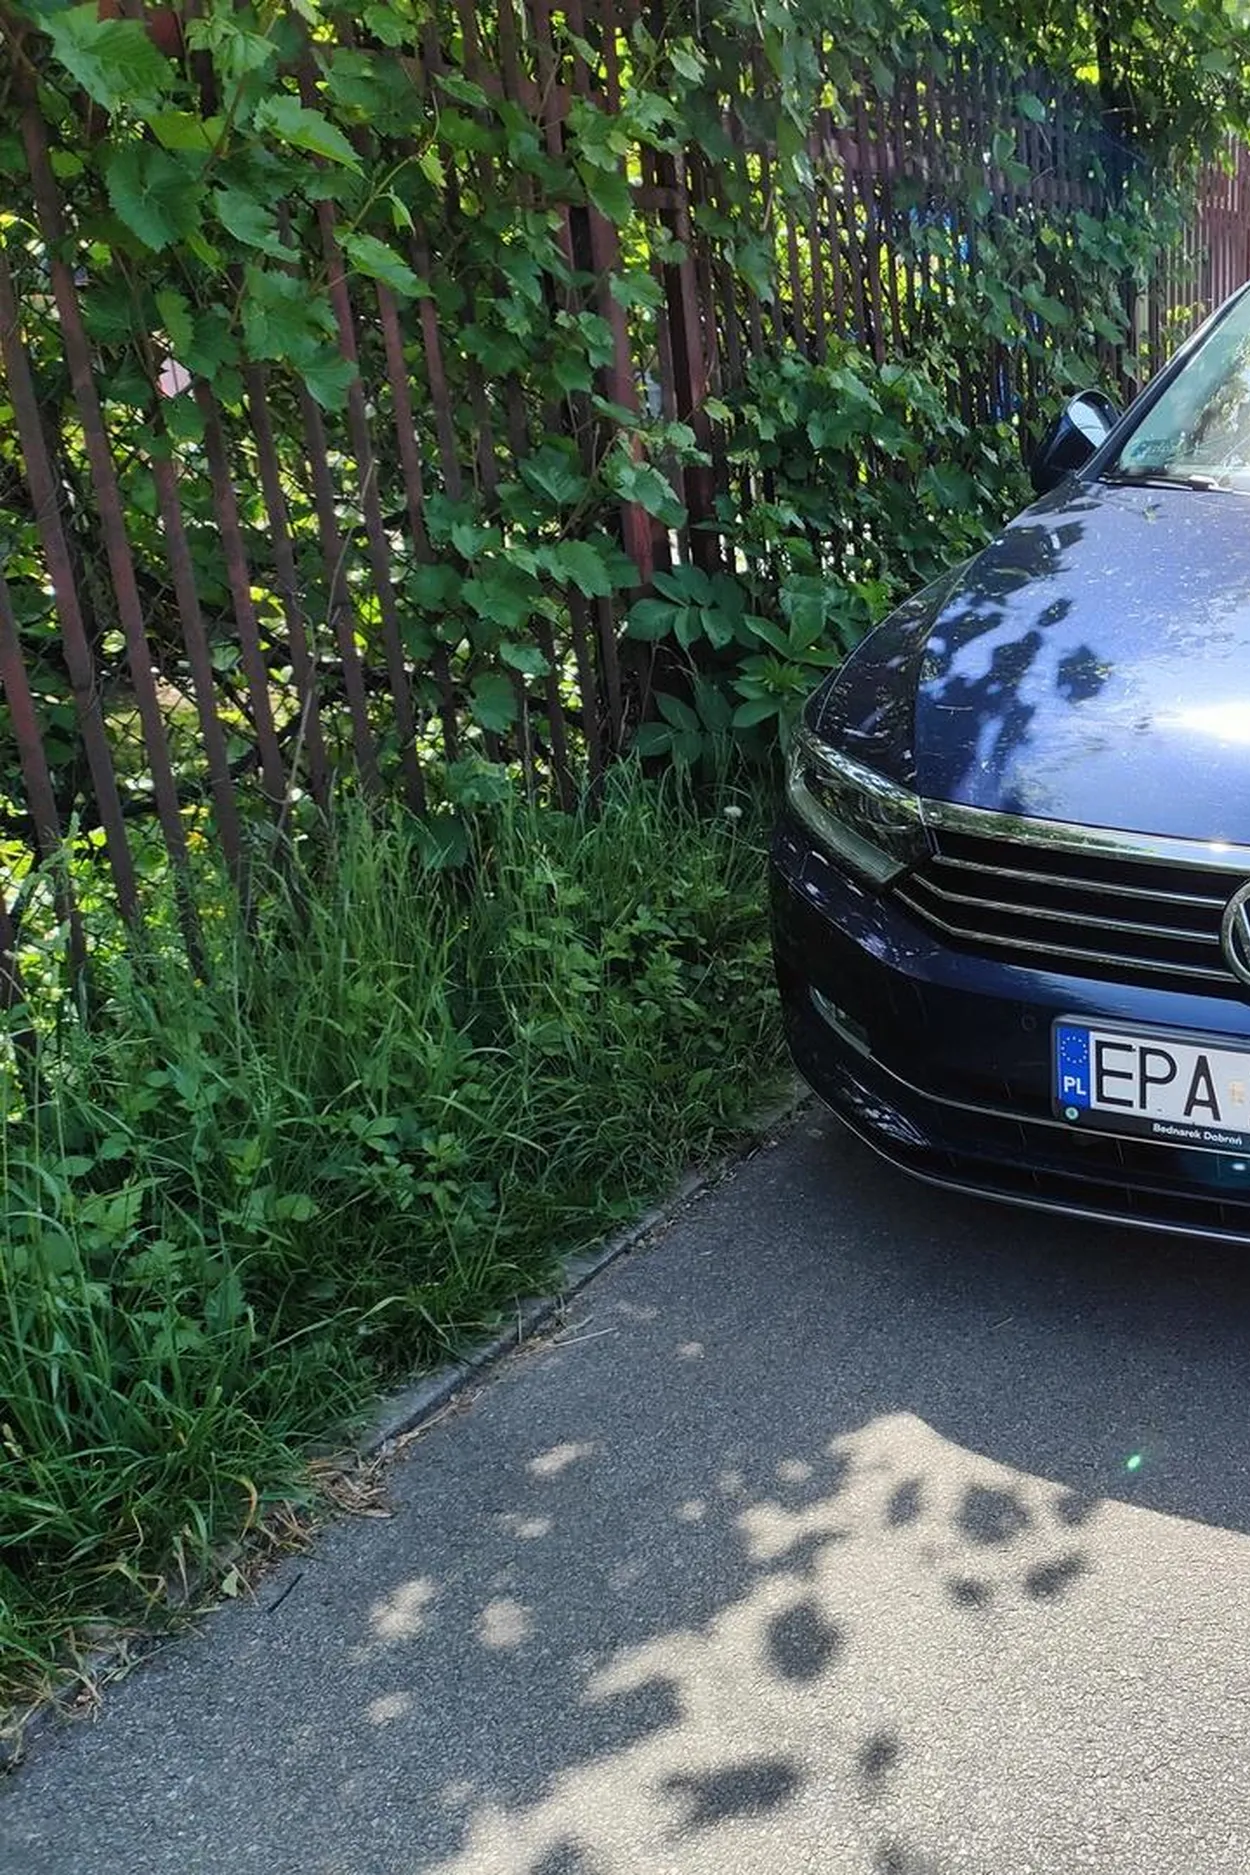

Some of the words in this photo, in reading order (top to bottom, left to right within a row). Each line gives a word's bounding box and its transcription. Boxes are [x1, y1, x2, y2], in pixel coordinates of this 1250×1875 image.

[1063, 1075, 1087, 1096] PL
[1094, 1039, 1222, 1122] EPA
[1152, 1122, 1202, 1141] Bednarek
